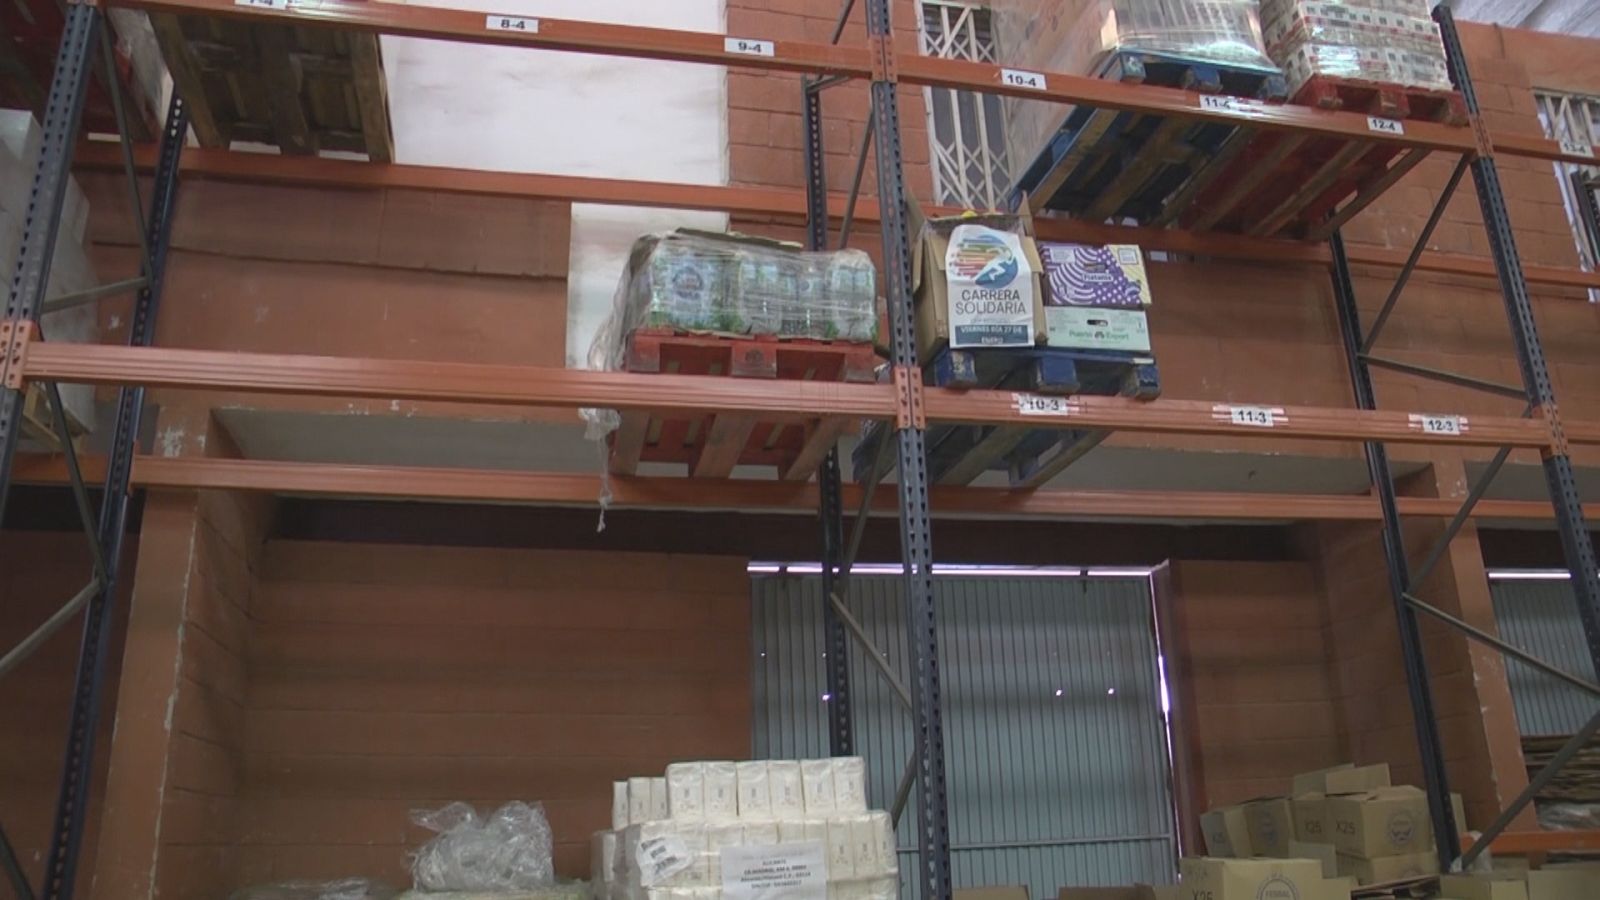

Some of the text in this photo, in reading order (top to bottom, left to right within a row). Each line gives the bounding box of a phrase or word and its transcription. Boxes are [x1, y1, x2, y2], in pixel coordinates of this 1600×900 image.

[500, 18, 525, 29] 8-4
[738, 41, 762, 53] 9-4
[1007, 73, 1037, 87] 10-4
[1372, 118, 1396, 131] 12-4
[961, 289, 1021, 301] CARRERA
[955, 301, 1027, 315] SOLIDARIA
[960, 325, 990, 333] VIERNES
[1004, 325, 1012, 333] 27
[1028, 399, 1060, 411] 10-3
[1238, 409, 1267, 423] 11-3
[1428, 419, 1454, 432] 12-3
[1335, 820, 1356, 835] X25
